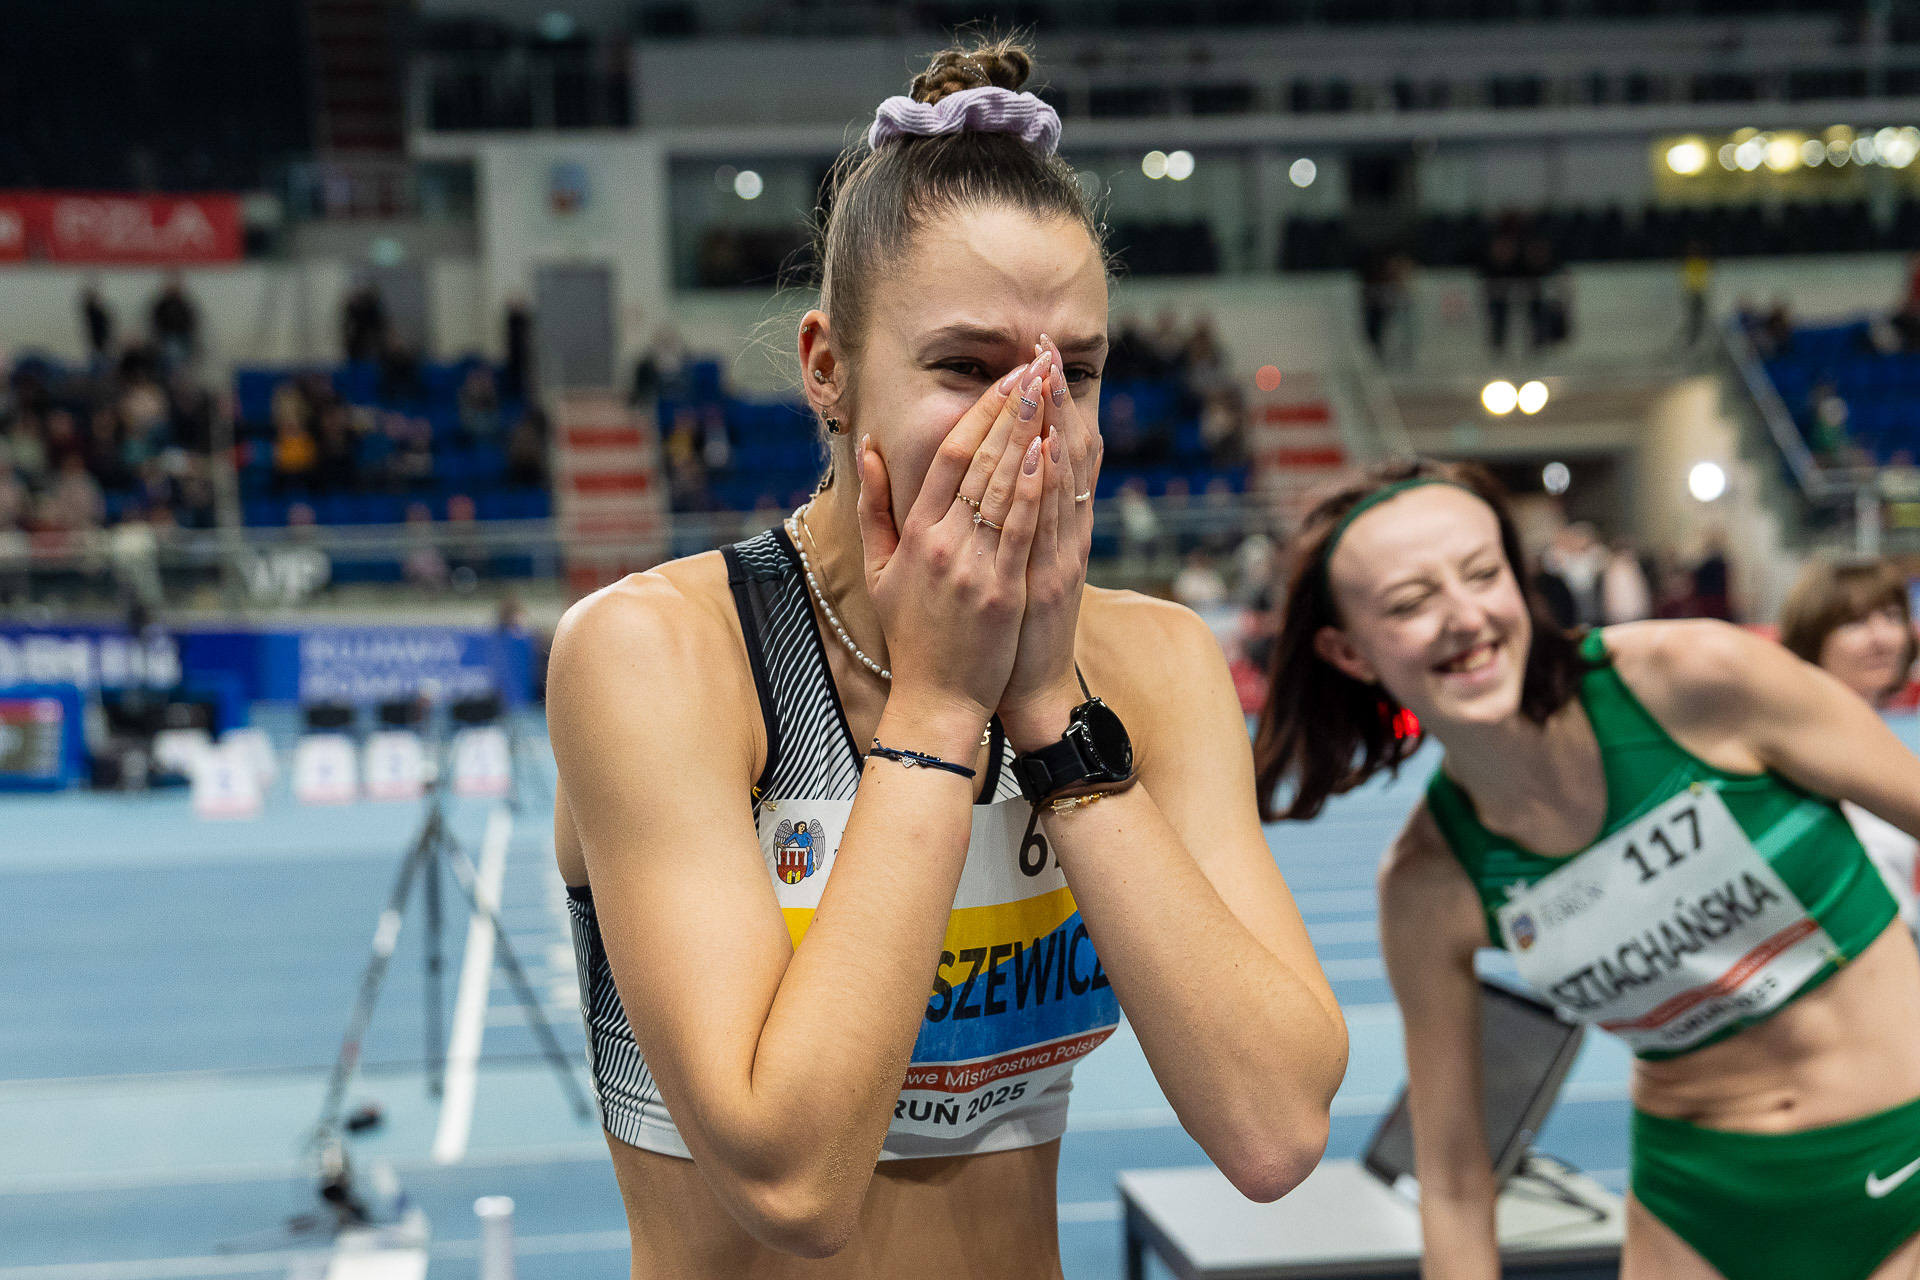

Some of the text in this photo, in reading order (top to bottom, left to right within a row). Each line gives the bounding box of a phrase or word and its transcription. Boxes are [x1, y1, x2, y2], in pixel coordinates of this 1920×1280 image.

[1019, 806, 1061, 877] 6
[1624, 806, 1703, 884] 117
[945, 1052, 1051, 1087] Mistrzostwa
[965, 1081, 1028, 1123] 2025
